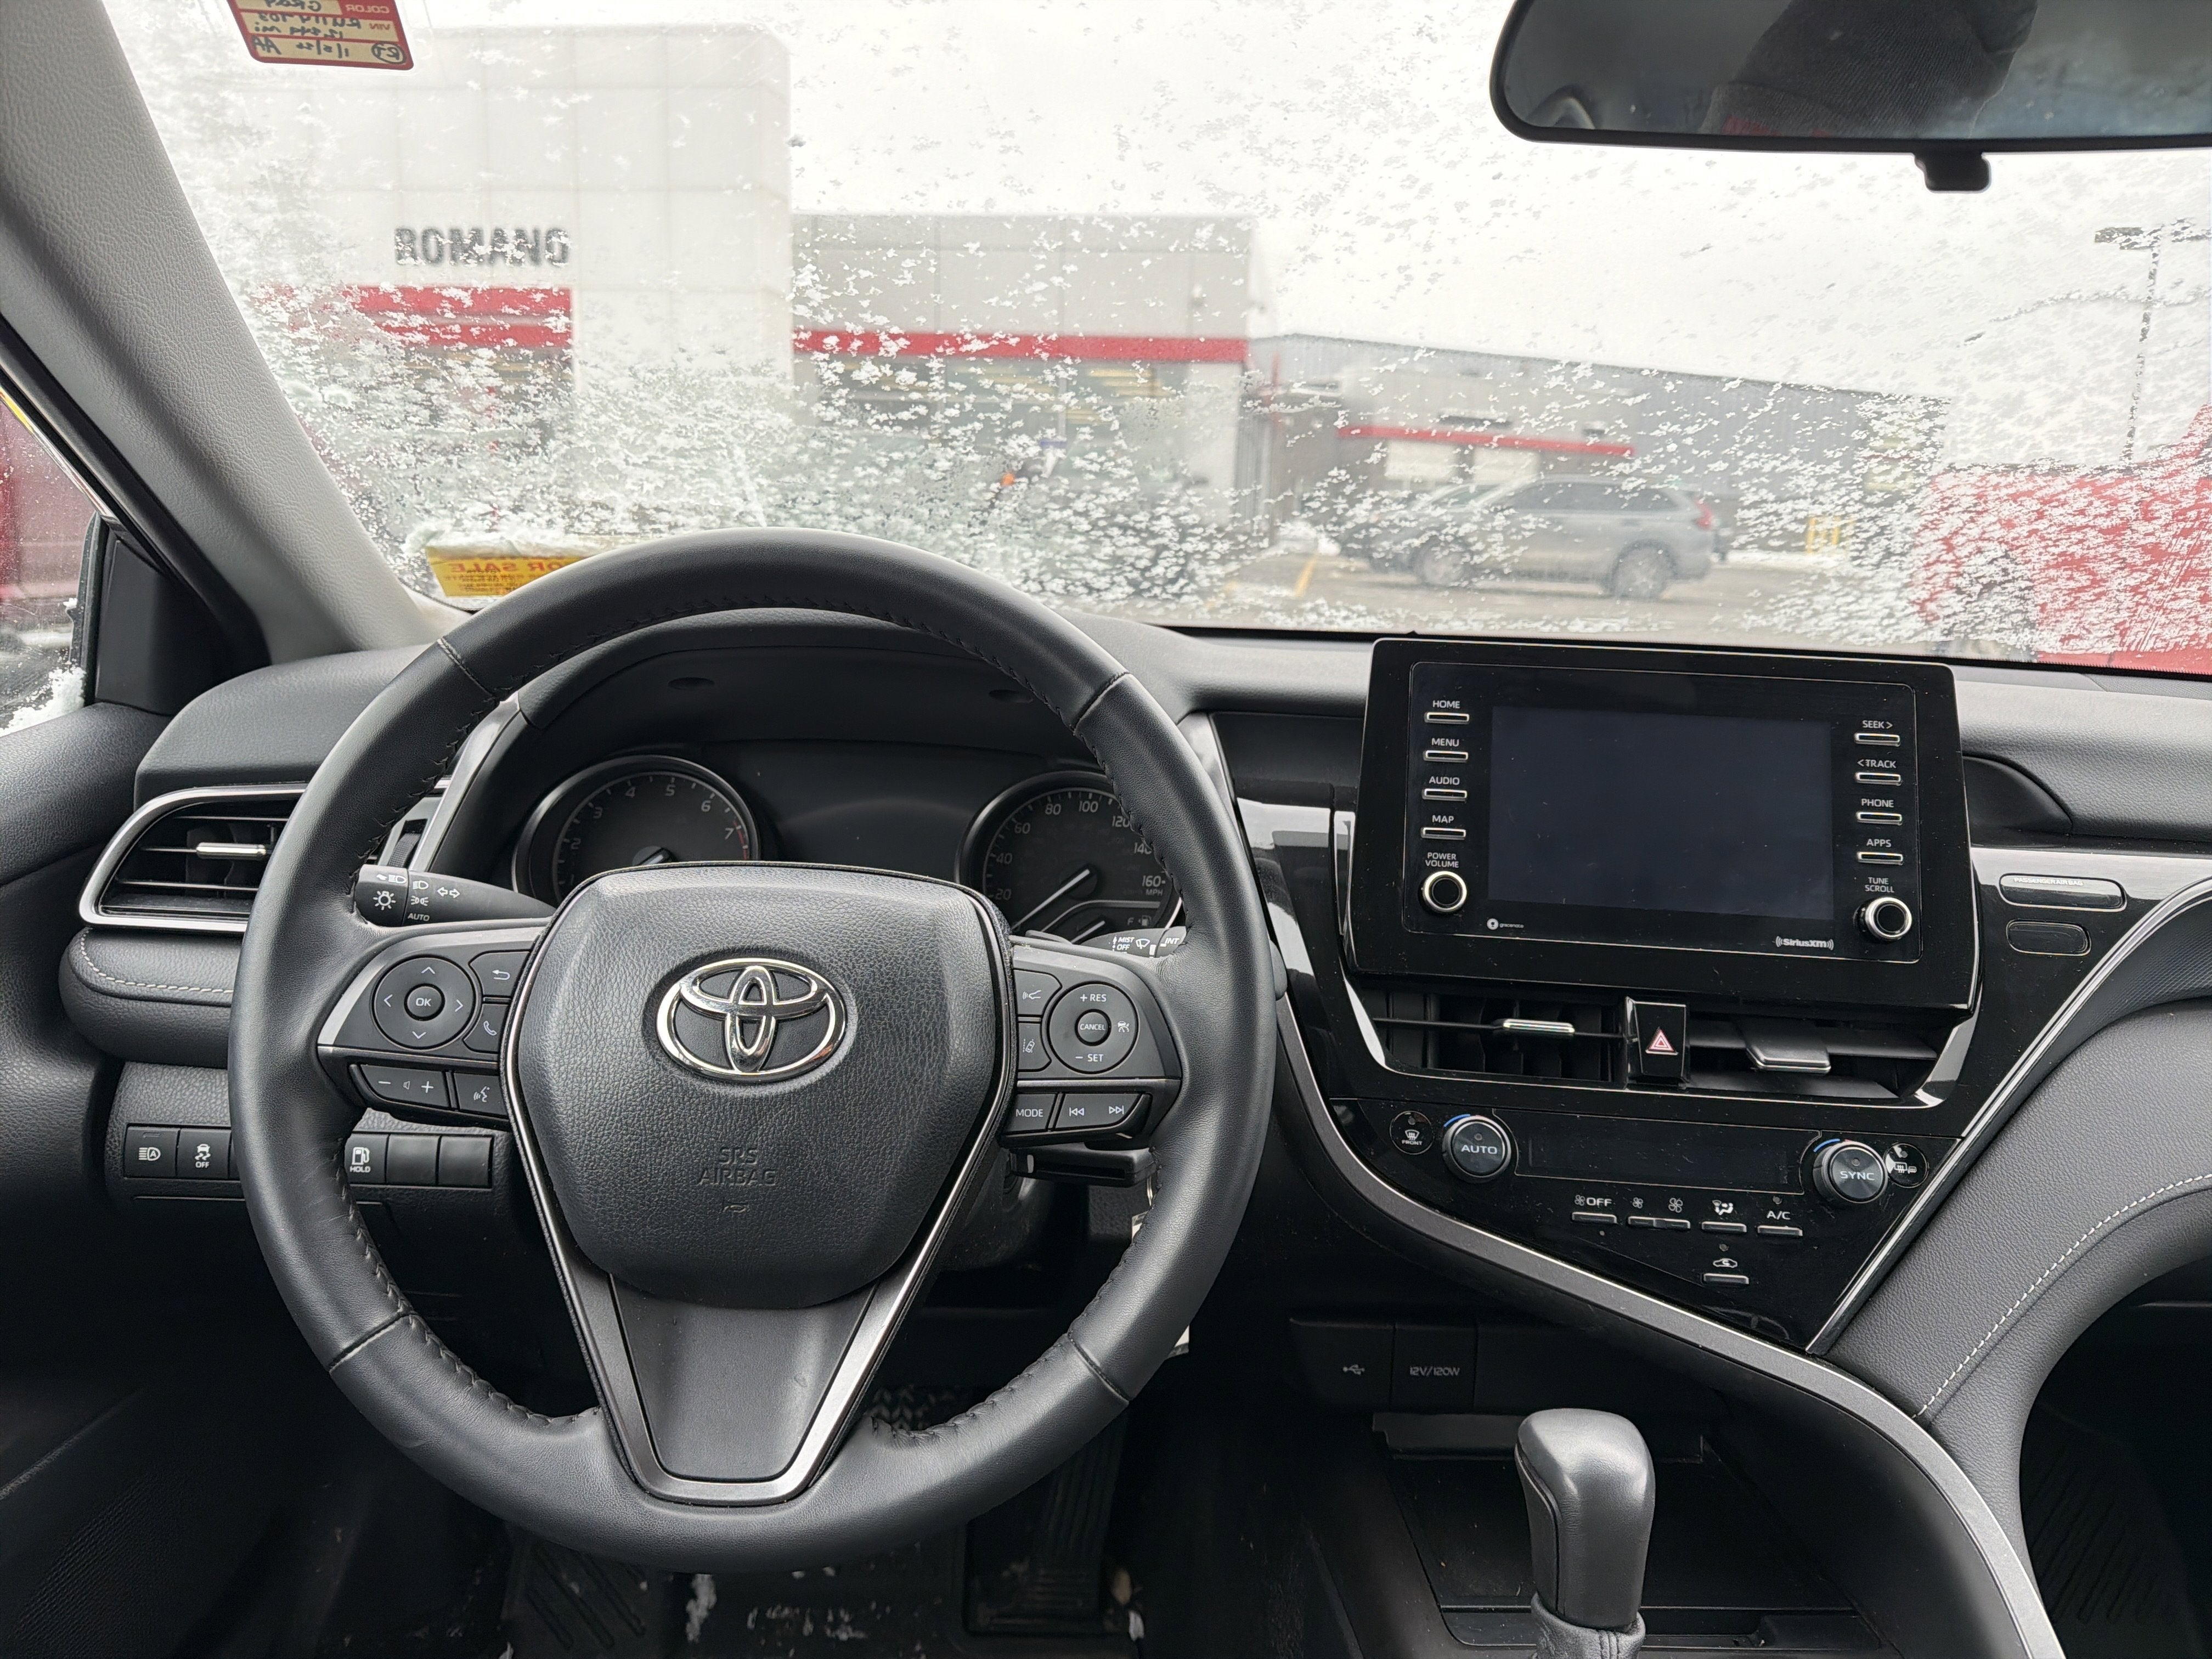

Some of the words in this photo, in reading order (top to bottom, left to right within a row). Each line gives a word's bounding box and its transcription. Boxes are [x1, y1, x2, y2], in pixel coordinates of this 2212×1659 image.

[1432, 700, 1460, 709] HOME
[1431, 738, 1459, 747] MENU
[1429, 776, 1460, 785] AUDIO
[625, 787, 635, 798] 4
[665, 785, 675, 796] 5
[701, 800, 711, 812] 6
[1079, 800, 1098, 813] 100
[1861, 799, 1894, 808] PHONE
[593, 807, 603, 819] 3
[1045, 803, 1062, 816] 80
[1111, 815, 1130, 827] 120
[1432, 815, 1454, 823] MAP
[1014, 822, 1031, 834] 60
[724, 828, 735, 839] 7
[571, 839, 581, 850] 2
[1866, 839, 1892, 848] APPS
[996, 853, 1013, 865] 40
[1427, 852, 1457, 860] POWER
[1425, 860, 1459, 868] VOLUME
[1142, 875, 1161, 887] 160
[1868, 877, 1889, 885] TUNE
[1865, 884, 1894, 893] SCROLL
[995, 889, 1012, 900] 20
[408, 913, 430, 922] AUTO
[415, 997, 432, 1007] OK
[1090, 994, 1107, 1002] RES
[1015, 1109, 1043, 1117] MODE
[1461, 1144, 1497, 1154] AUTO
[1840, 1171, 1875, 1181] SYNC
[1587, 1197, 1612, 1207] OFF
[1767, 1211, 1791, 1220] A/C
[1409, 1366, 1460, 1376] 12V/120W
